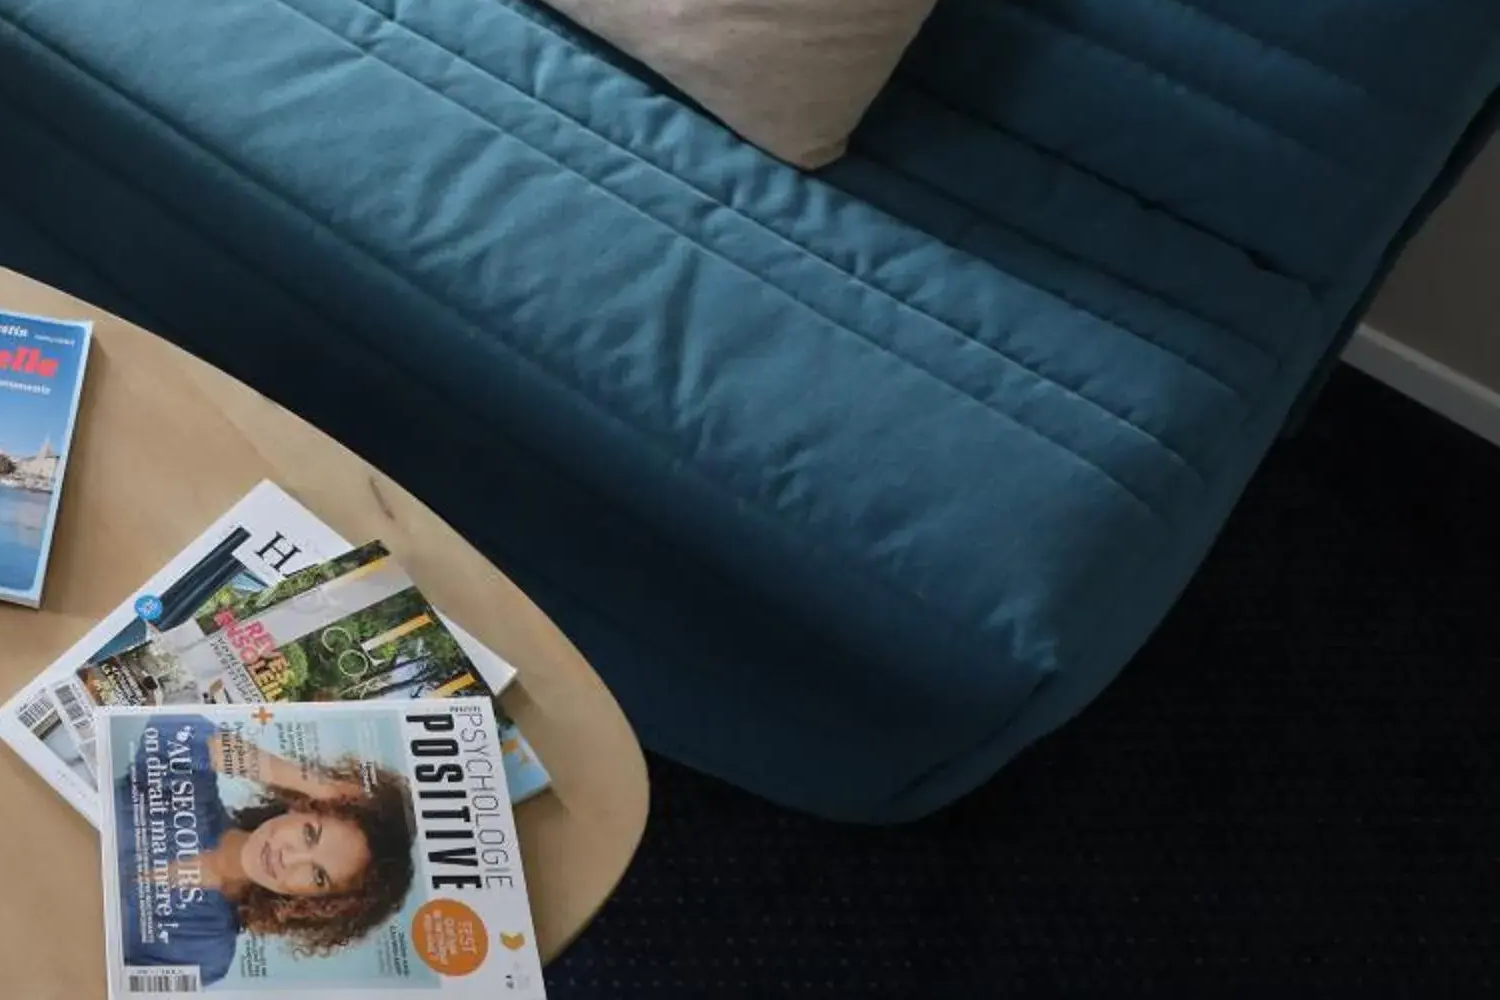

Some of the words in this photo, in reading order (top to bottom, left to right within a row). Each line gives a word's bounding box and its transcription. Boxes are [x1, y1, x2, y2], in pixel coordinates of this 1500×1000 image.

[144, 727, 159, 753] on
[146, 756, 169, 815] dirait
[151, 820, 167, 854] ma
[171, 779, 204, 909] SECOURS,
[405, 714, 482, 889] POSITIVE
[457, 713, 513, 889] PSYCHOLOGIE
